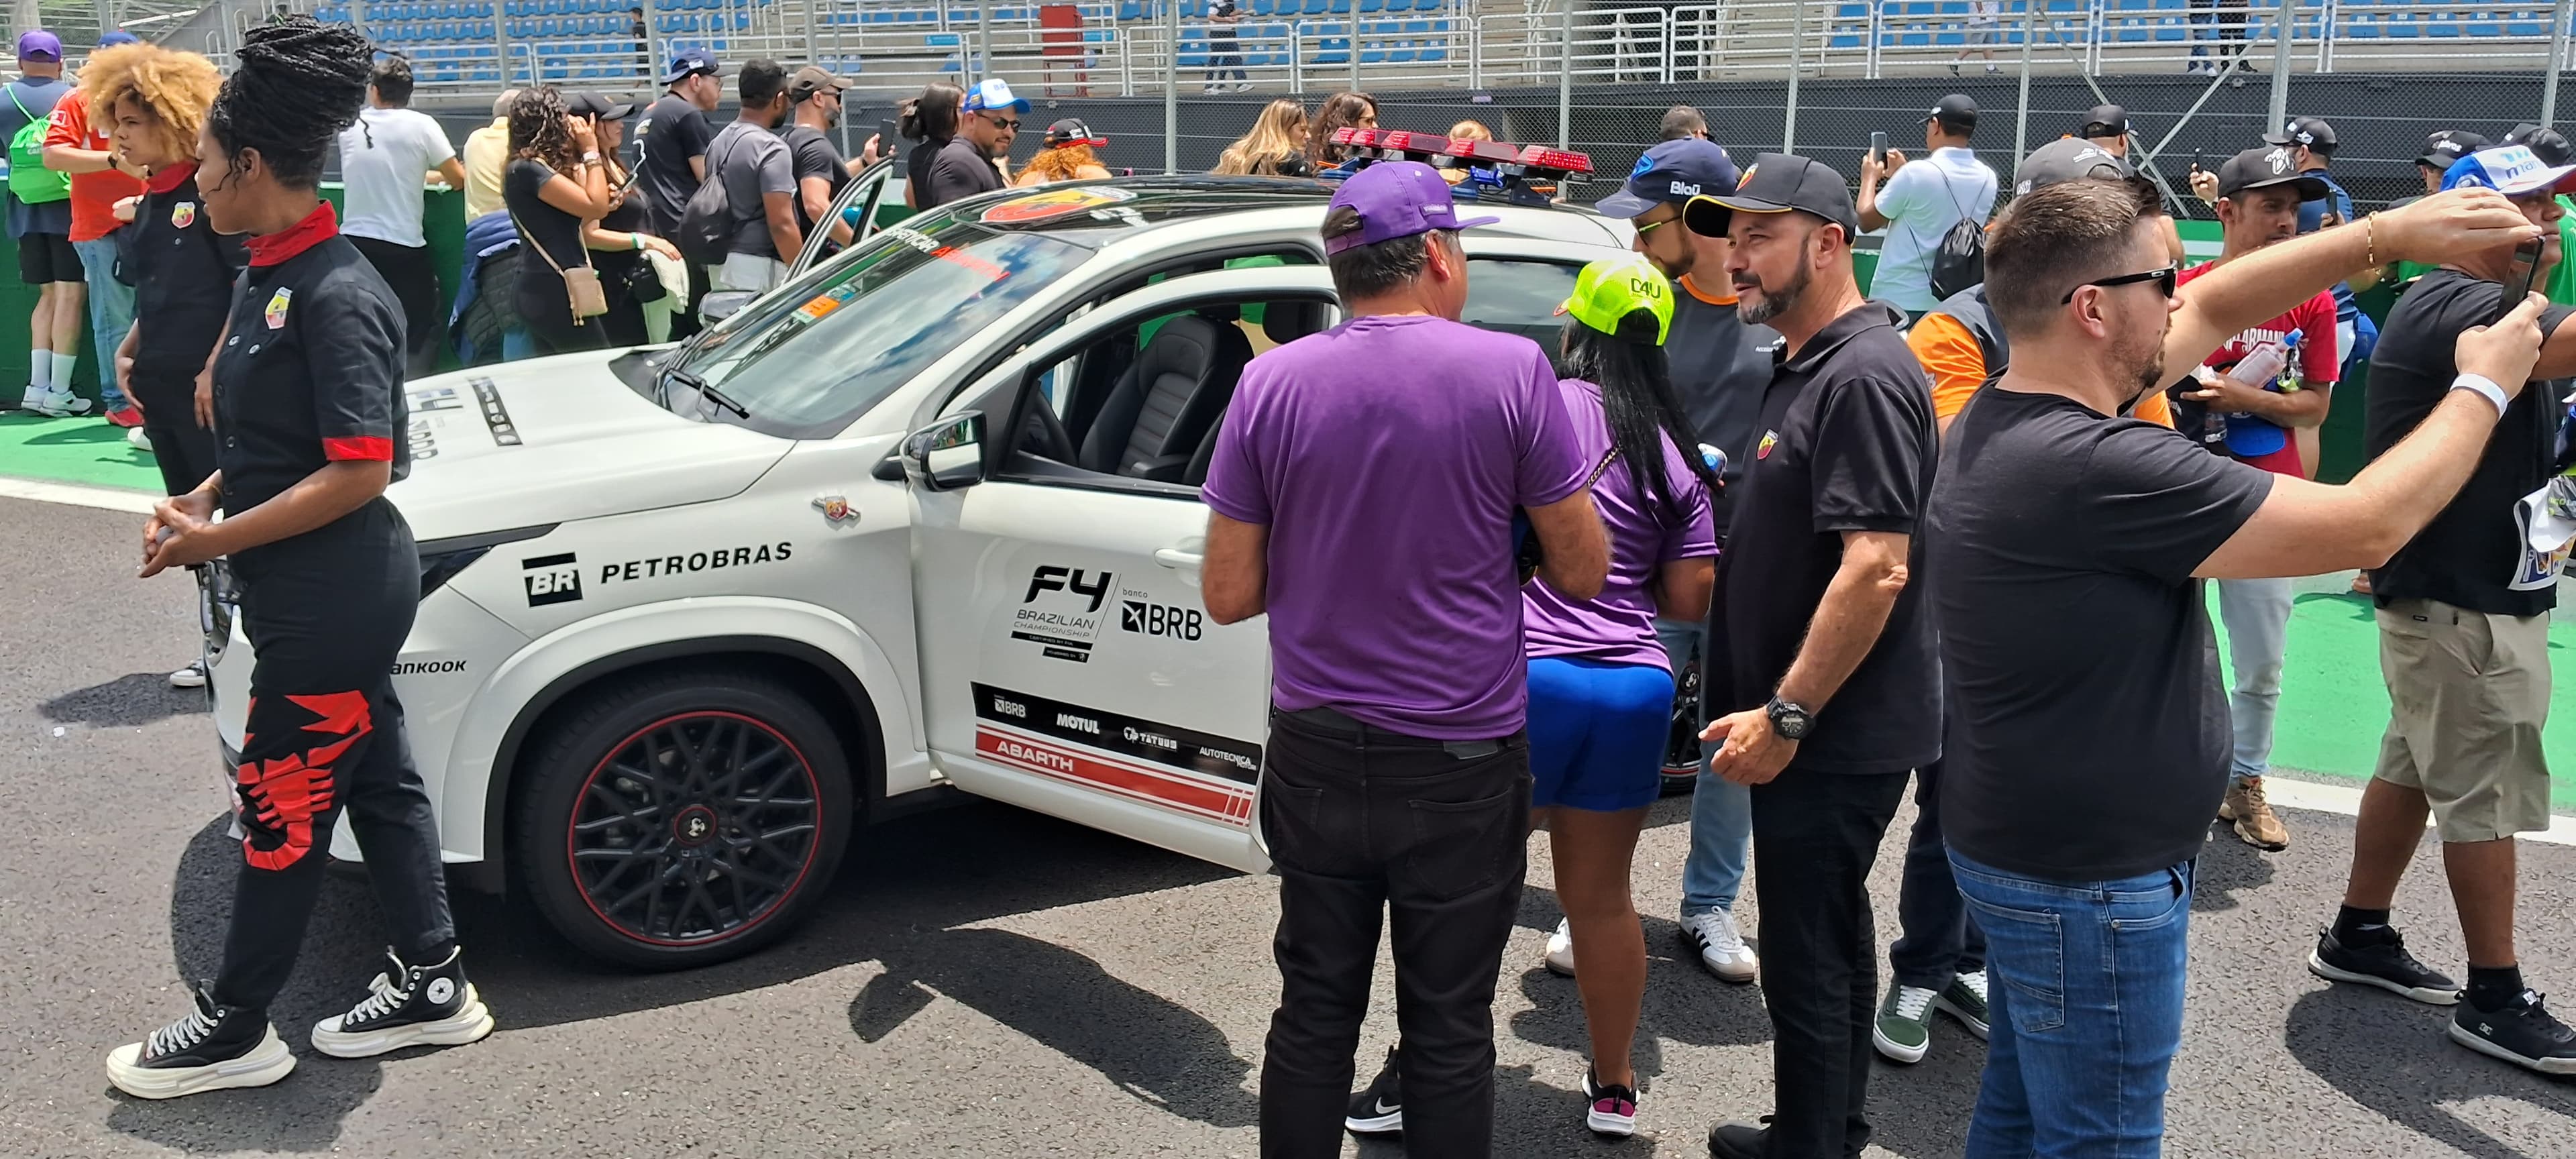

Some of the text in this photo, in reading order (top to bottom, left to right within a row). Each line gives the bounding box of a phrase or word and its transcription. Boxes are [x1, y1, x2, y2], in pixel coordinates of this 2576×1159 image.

[1631, 278, 1661, 299] D4U
[531, 542, 792, 596] BR PETROBRAS
[1024, 565, 1112, 613] F4
[1122, 588, 1148, 598] banco
[1014, 621, 1090, 638] CHAMPIONSHIP
[1016, 609, 1095, 630] BRAZILIAN
[1148, 604, 1203, 641] BRB
[1005, 701, 1026, 718] BRB
[1056, 713, 1099, 734] MOTUL
[997, 740, 1073, 771] ABARTH
[1199, 747, 1251, 765] AUTOTECNICA
